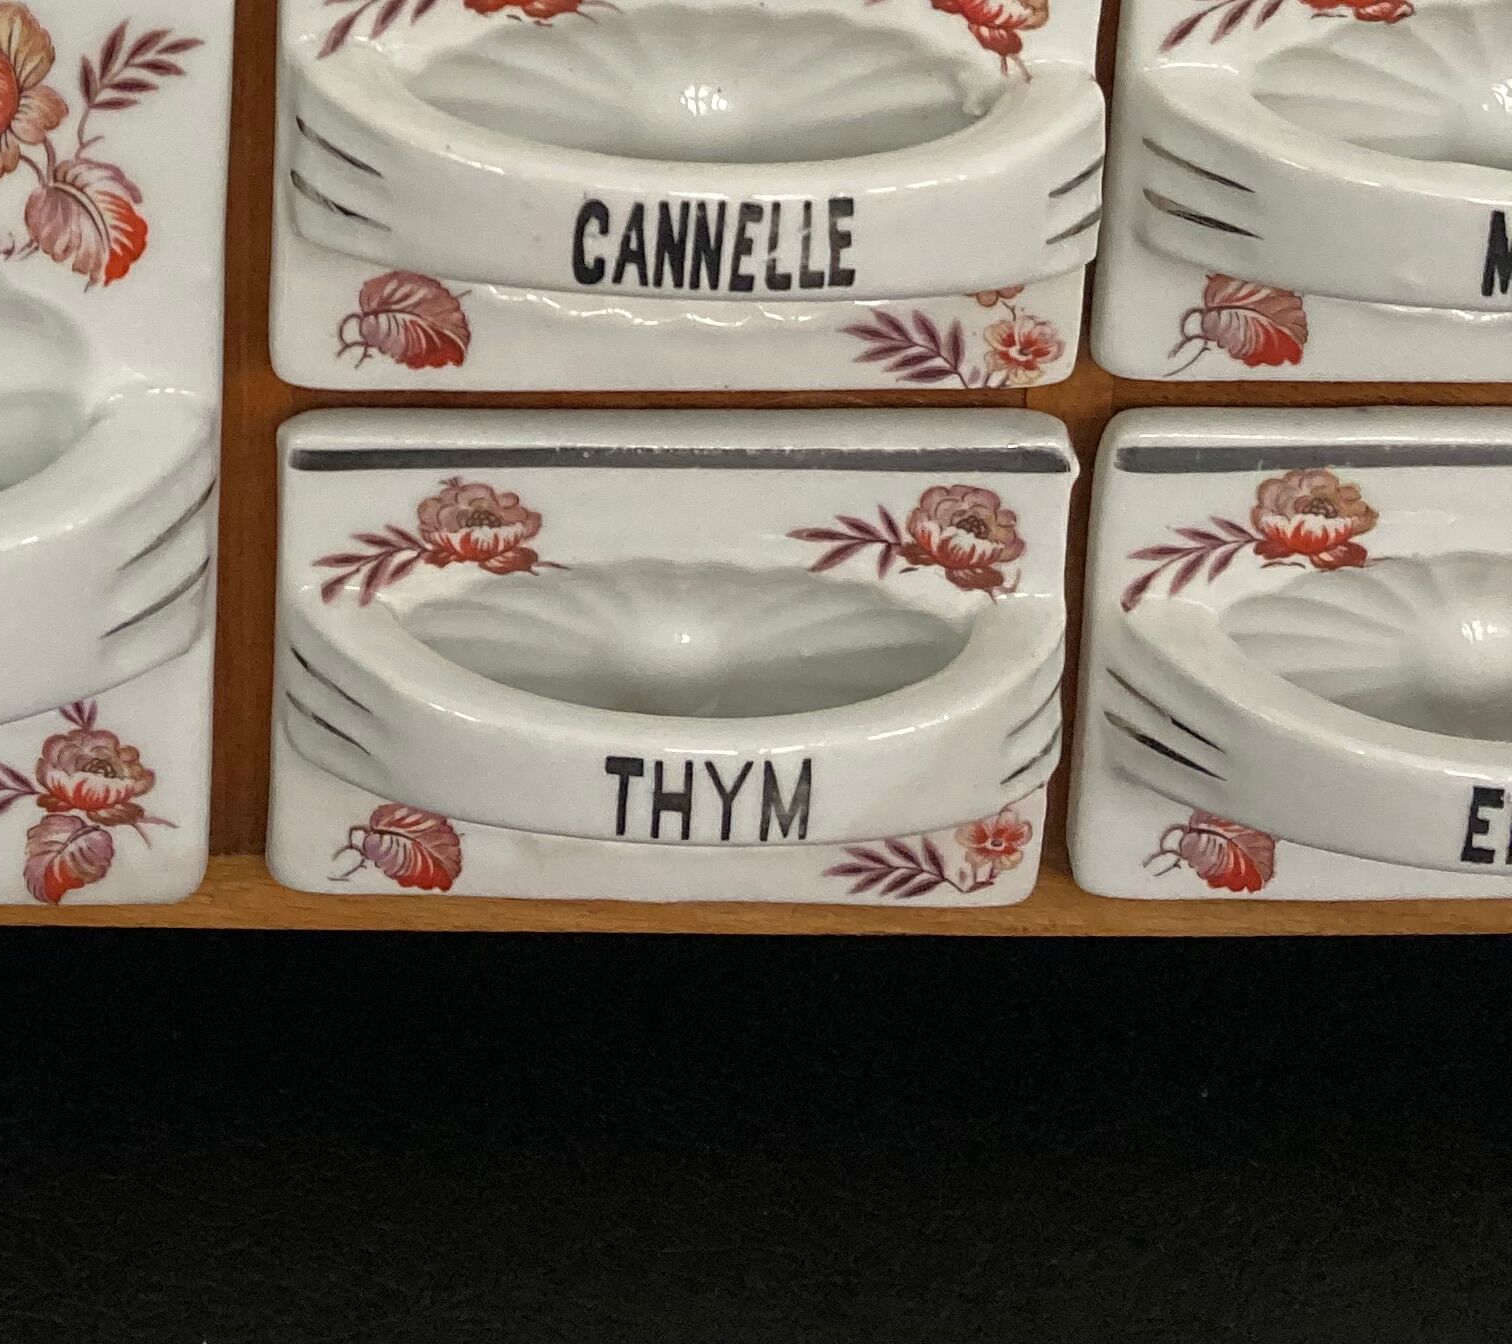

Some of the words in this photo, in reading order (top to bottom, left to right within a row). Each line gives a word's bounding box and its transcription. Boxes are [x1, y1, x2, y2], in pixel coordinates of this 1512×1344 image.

[572, 197, 856, 293] CANNELLE
[604, 755, 812, 842] THYM
[1460, 785, 1512, 865] E
